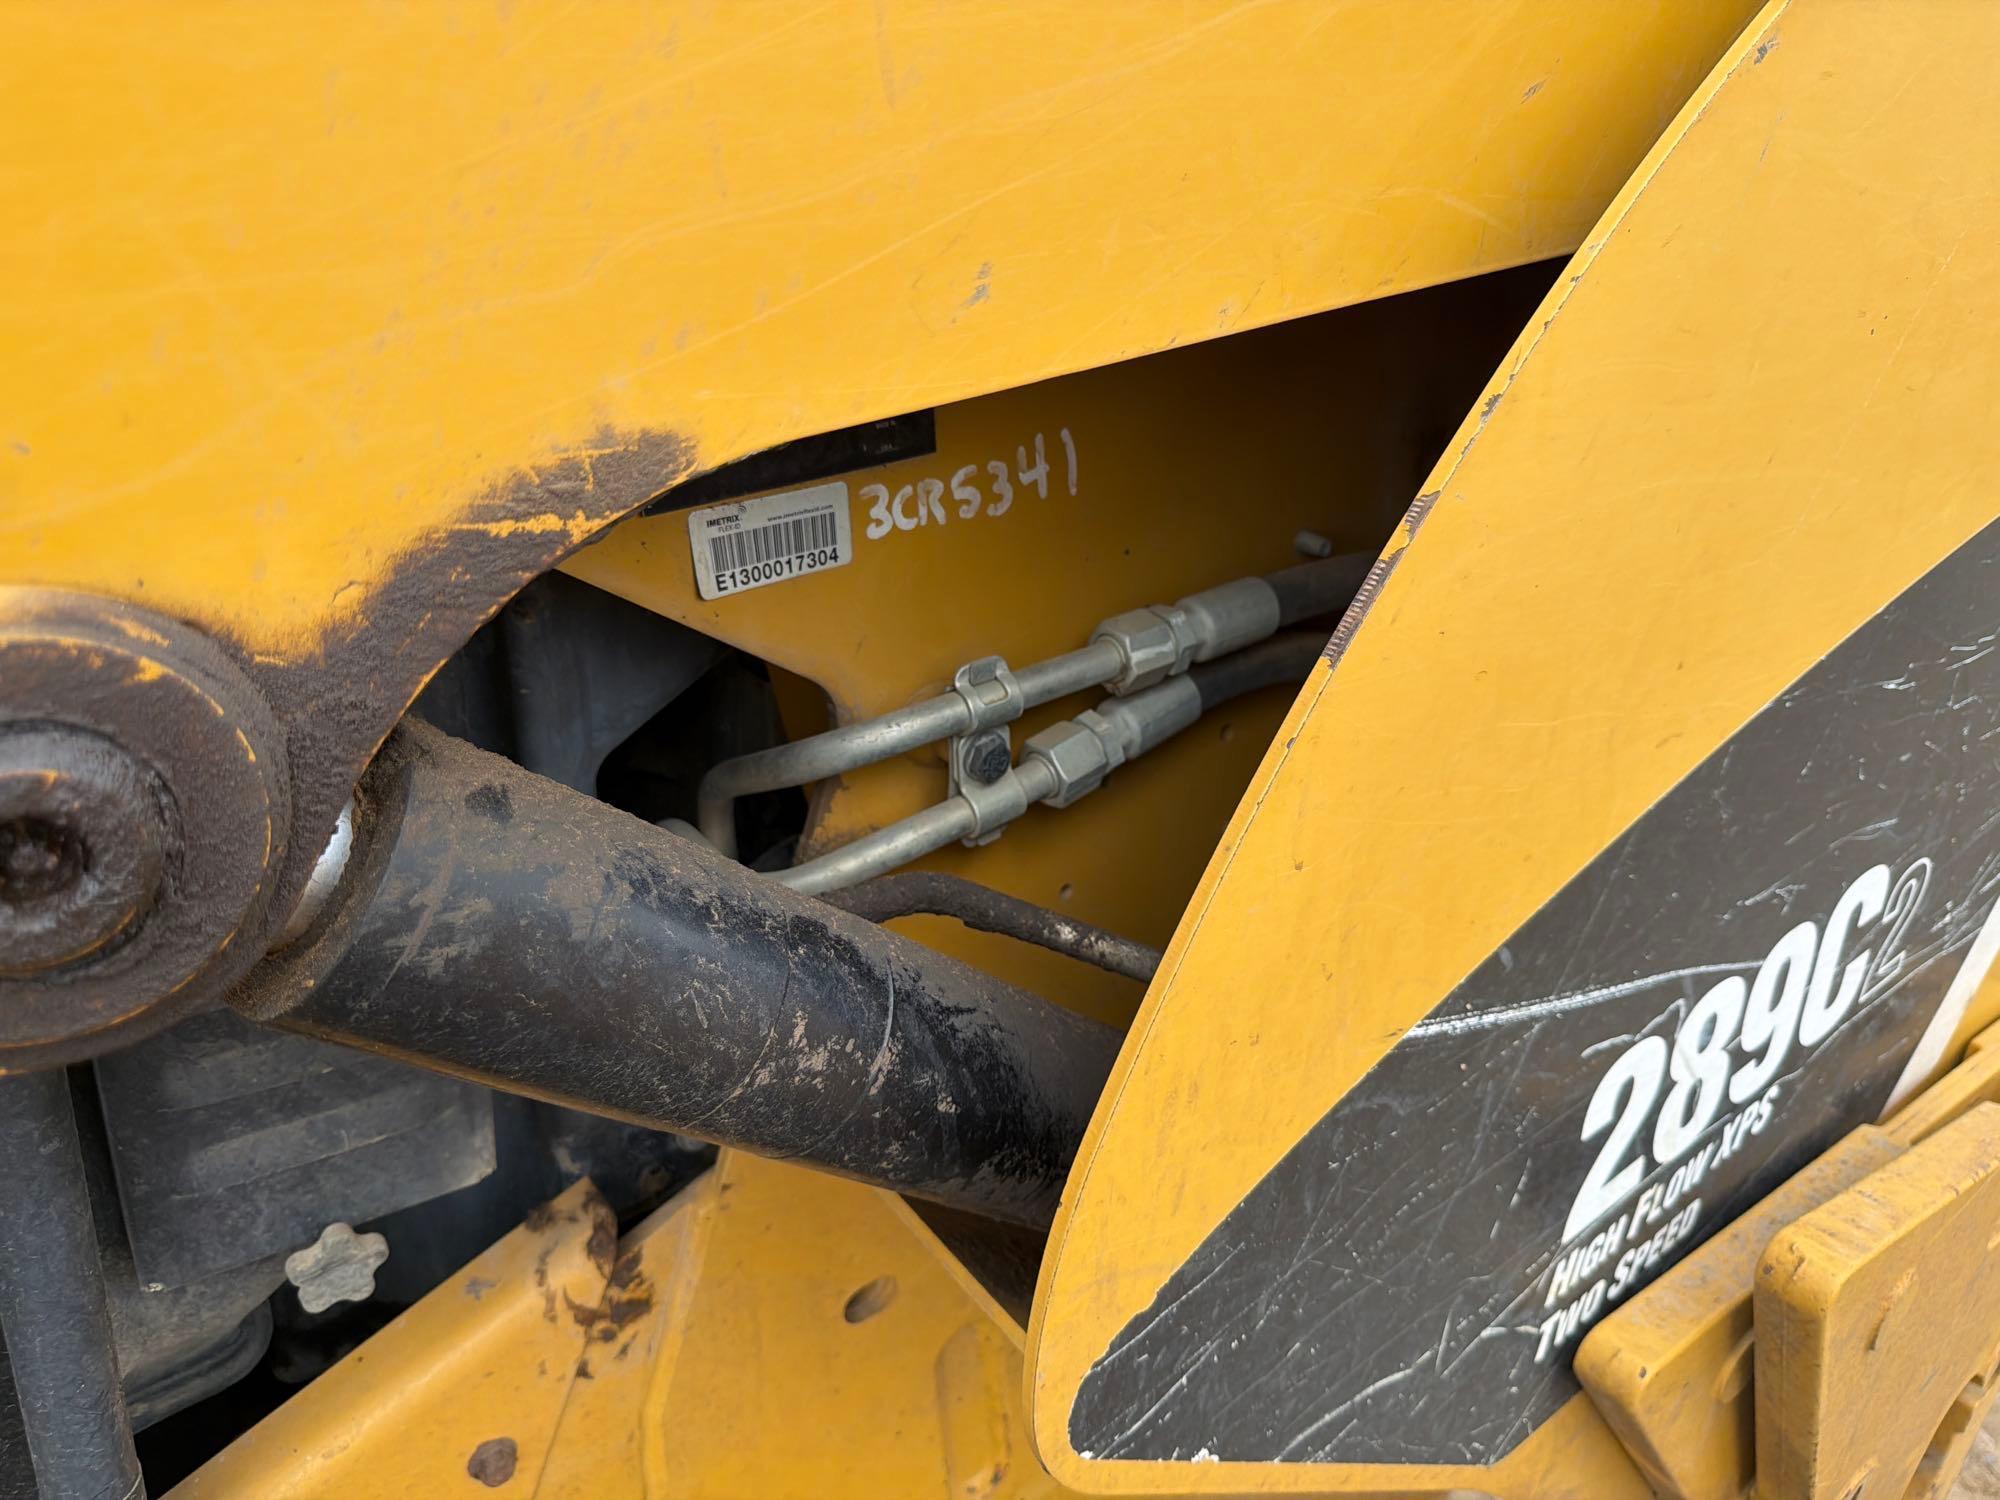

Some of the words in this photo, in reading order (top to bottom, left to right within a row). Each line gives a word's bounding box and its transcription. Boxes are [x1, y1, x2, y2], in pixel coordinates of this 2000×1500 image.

[706, 515, 740, 528] IMETRIX
[715, 547, 839, 592] E1300017304
[1710, 1085, 1781, 1170] XPS
[1606, 1198, 1701, 1300] SPEED
